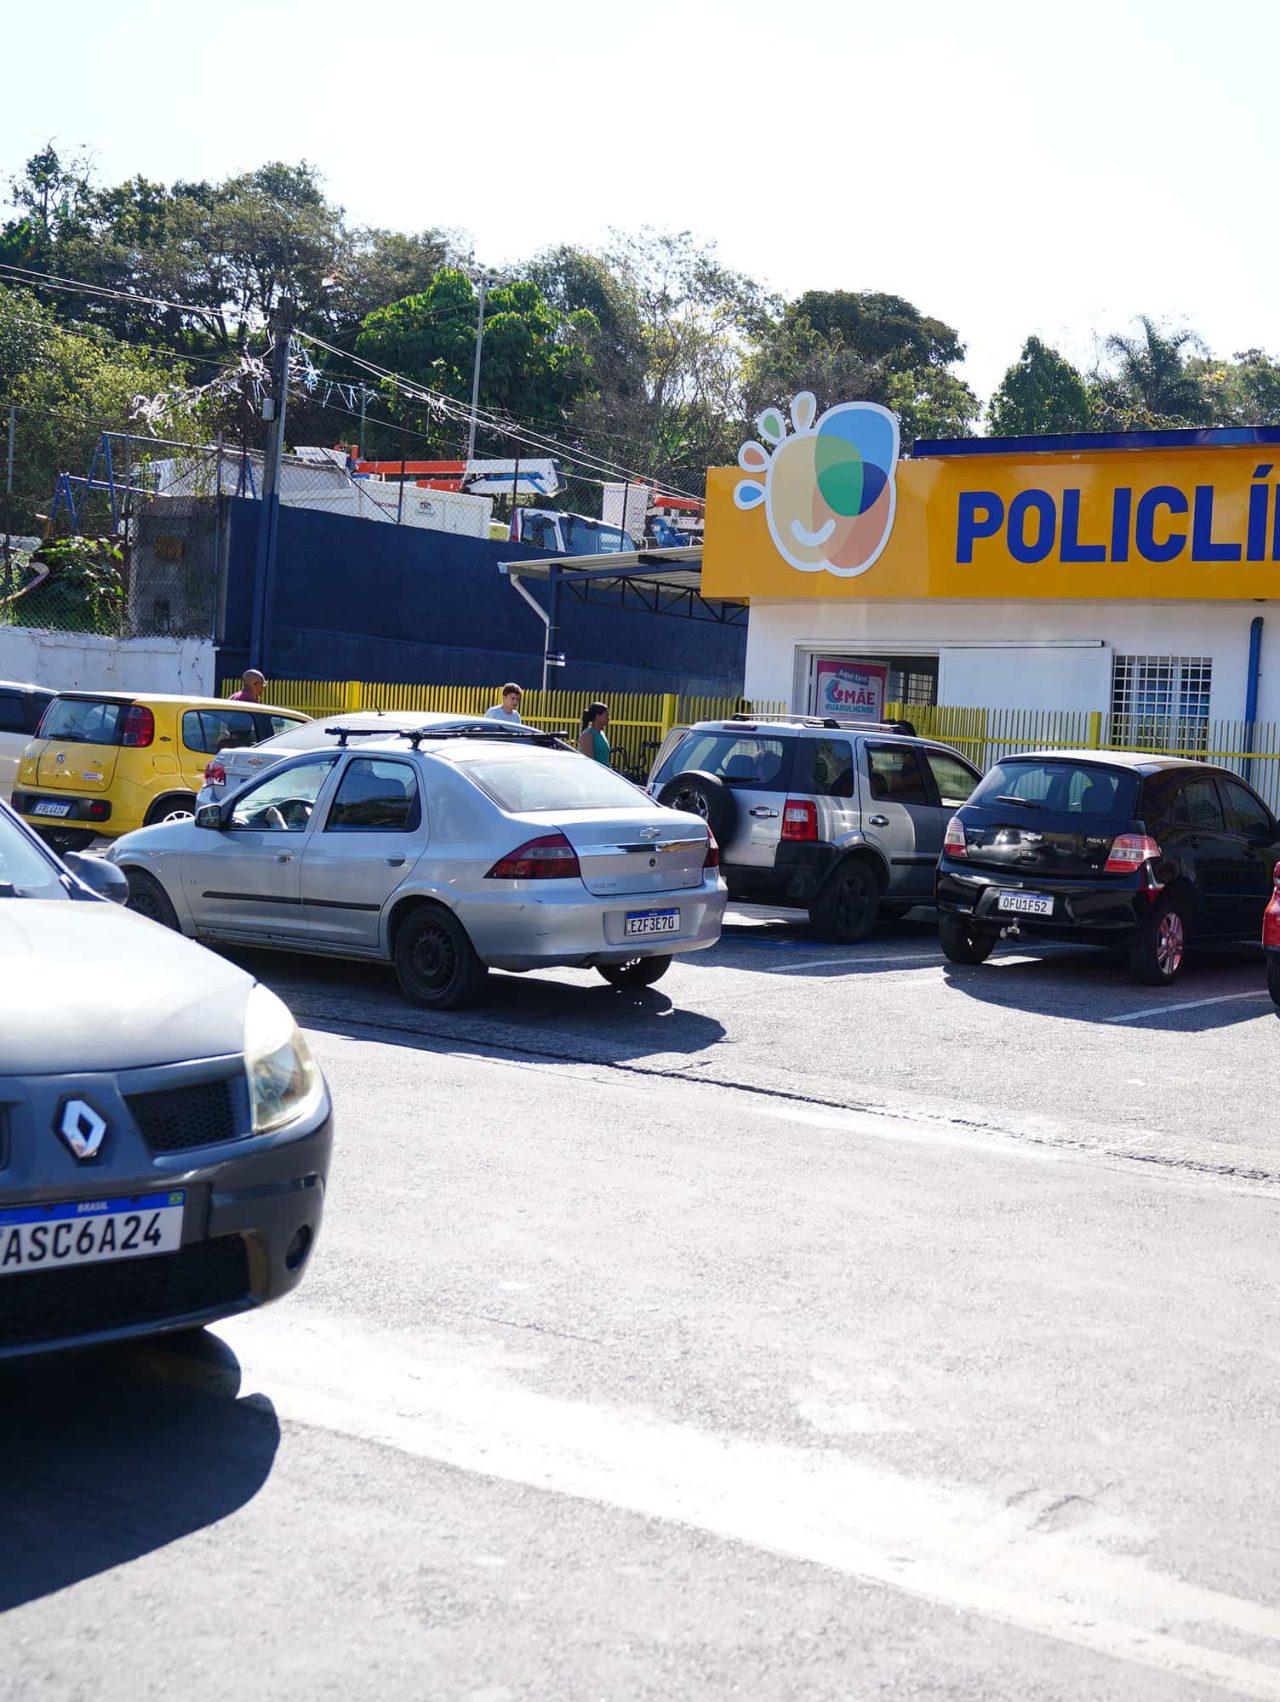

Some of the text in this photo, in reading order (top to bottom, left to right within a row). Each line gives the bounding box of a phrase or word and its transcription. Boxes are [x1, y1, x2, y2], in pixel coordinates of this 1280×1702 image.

[844, 687, 875, 705] MÃE
[1002, 897, 1048, 914] OFU1F52
[631, 916, 675, 933] EZF3E70
[77, 1201, 109, 1213] BRASIL
[2, 1212, 162, 1267] ASC6A24
